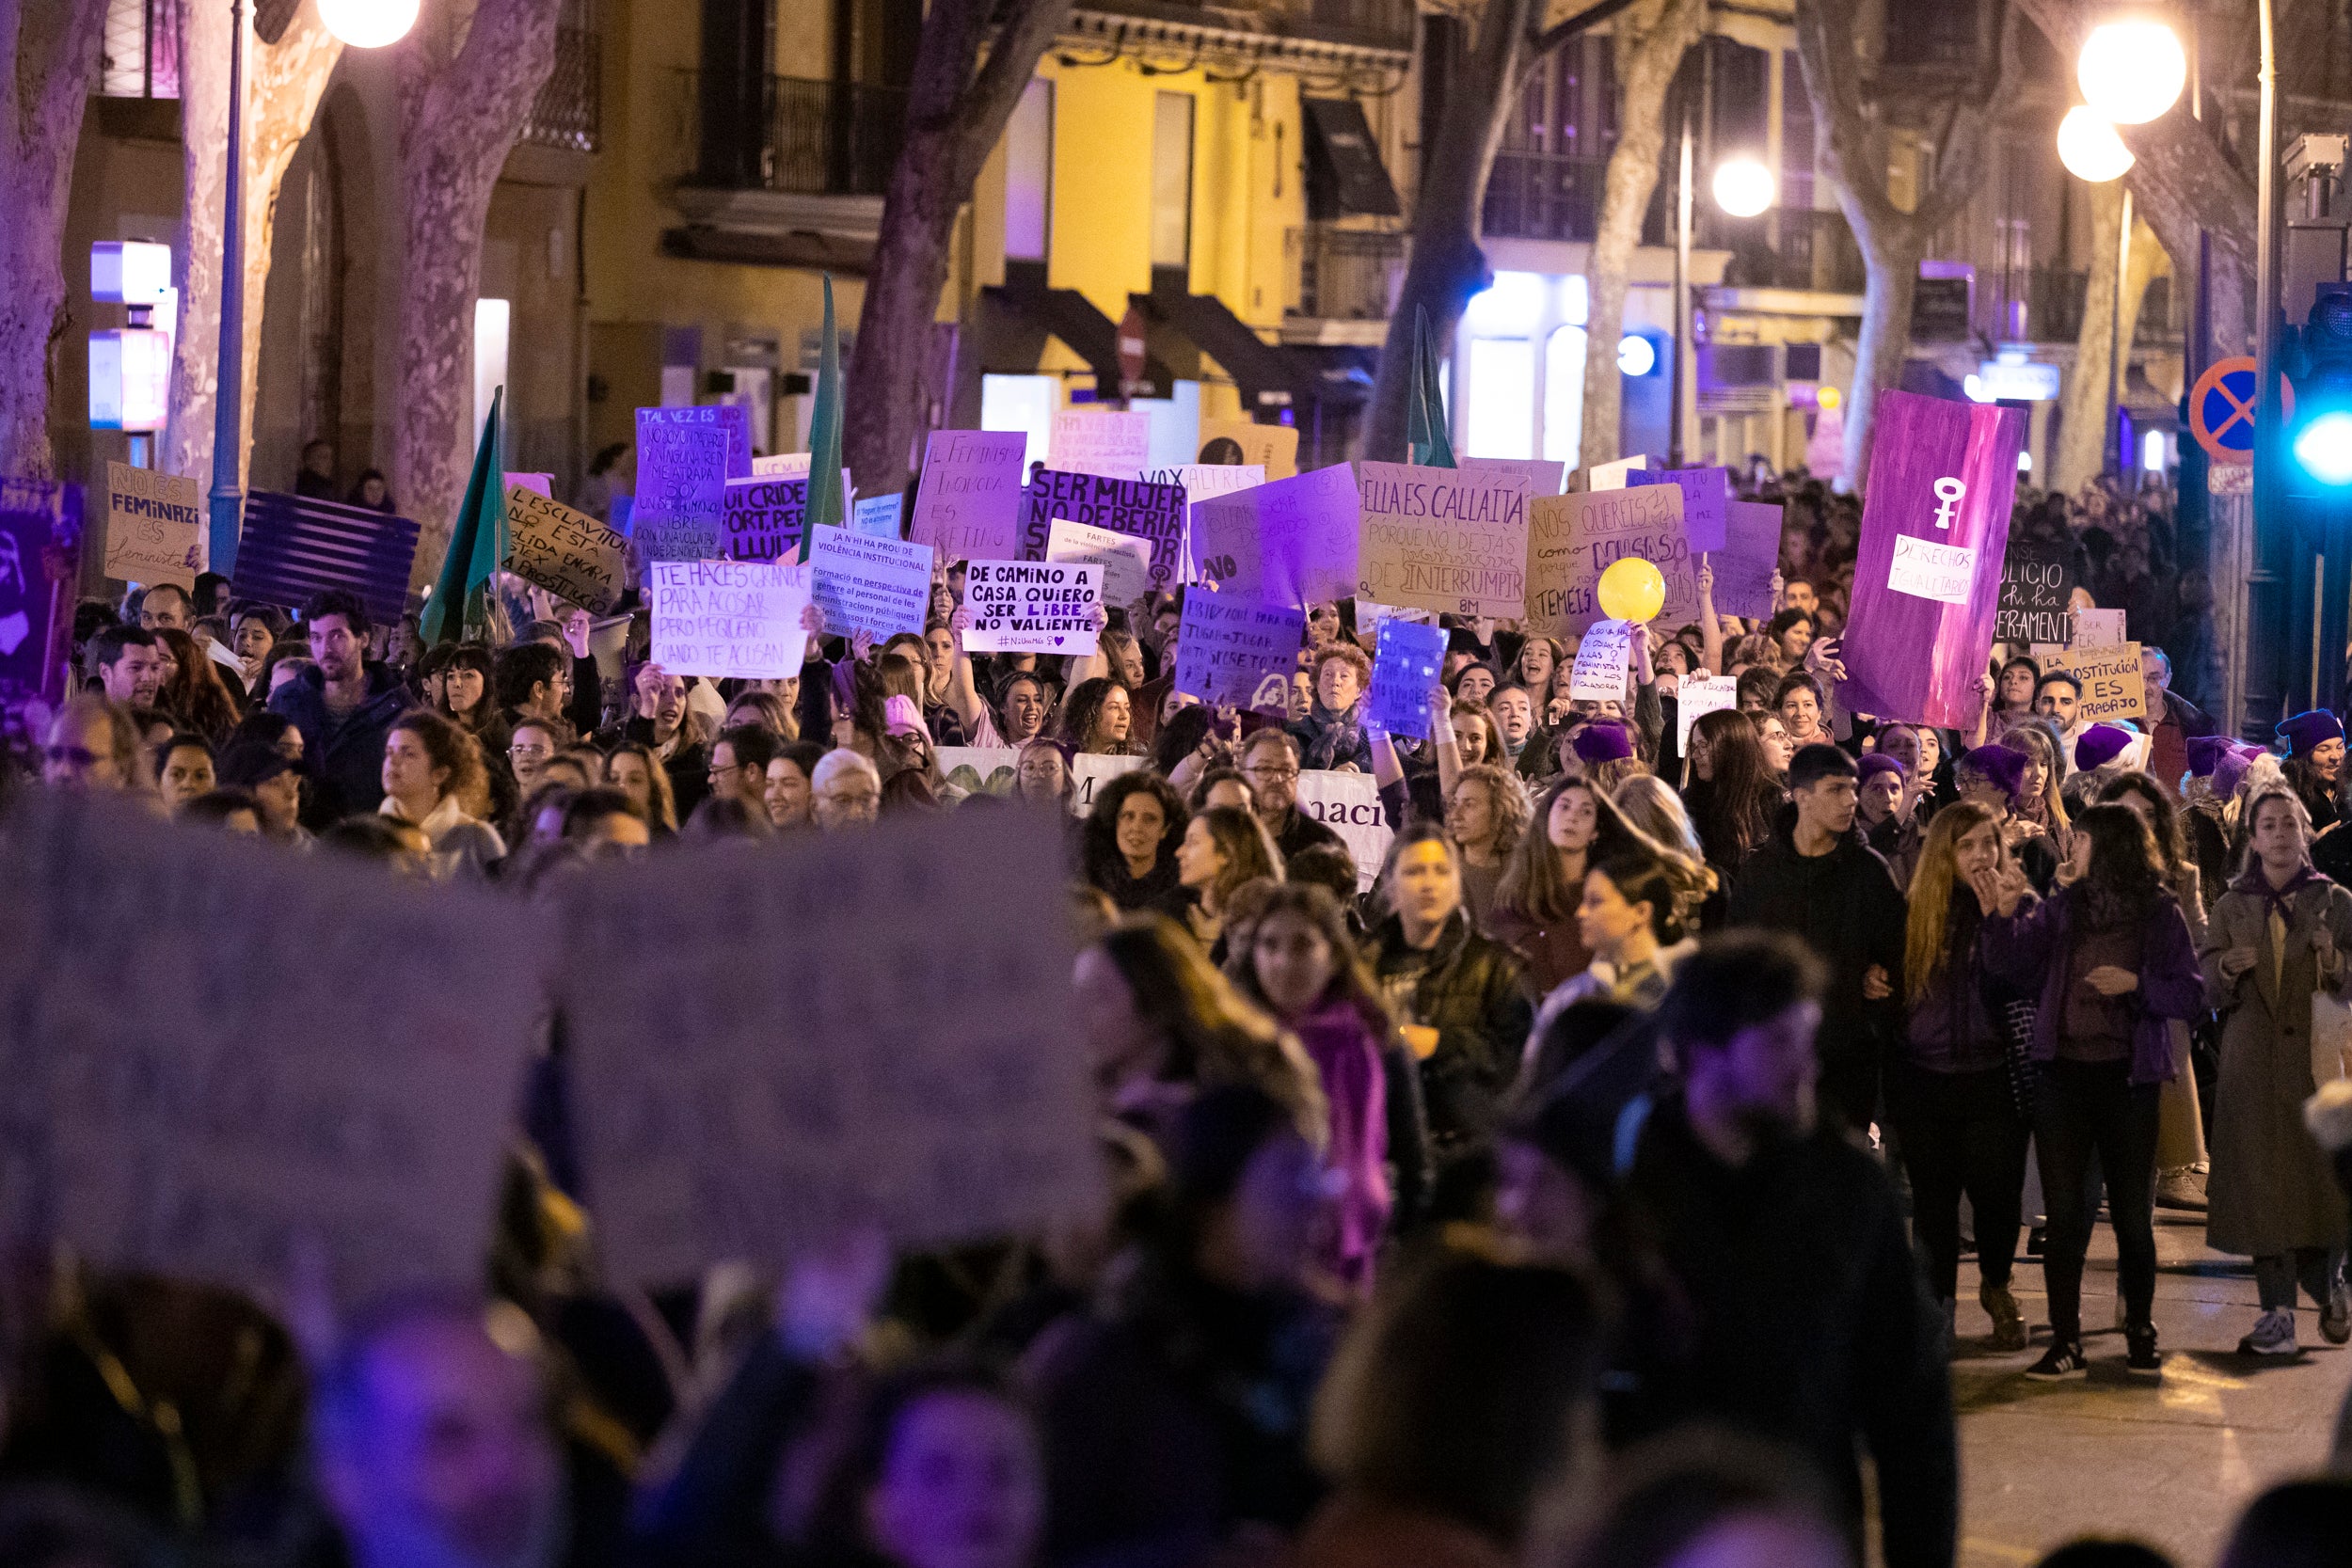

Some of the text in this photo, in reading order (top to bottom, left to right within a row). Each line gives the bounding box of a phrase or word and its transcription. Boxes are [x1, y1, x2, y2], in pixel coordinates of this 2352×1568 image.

[641, 409, 715, 422] TAL VEZ ES
[657, 449, 699, 465] NINGUNA
[704, 451, 723, 466] RED
[948, 436, 1024, 465] FEMINISMO
[652, 466, 669, 480] ME
[1691, 472, 1708, 484] TU
[112, 467, 183, 502] NO ES
[664, 481, 699, 499] SOY
[748, 478, 807, 510] CRIDE
[1033, 470, 1090, 503] SER
[1094, 477, 1186, 515] MUJER
[640, 497, 656, 510] UN
[931, 504, 956, 521] ES
[1031, 498, 1069, 523] NO
[1364, 480, 1523, 525] ELLA ES CALLAITA
[508, 506, 540, 529] NO
[659, 515, 699, 530] LIBRE
[722, 508, 771, 534] ORT,
[1532, 507, 1571, 542] NOS
[137, 518, 165, 544] ES
[636, 528, 657, 542] CON
[1087, 532, 1117, 546] FARTES
[1369, 523, 1422, 547] PORQUE
[1427, 530, 1449, 549] NO
[643, 544, 713, 560] INDEPENDIENTE
[833, 532, 843, 542] JA
[864, 537, 876, 548] HA
[877, 542, 900, 553] PROU
[901, 546, 914, 556] DE
[1537, 545, 1589, 559] como
[1896, 538, 1972, 570] DERECHOS
[818, 542, 926, 572] VIOLÈNCIA INSTITUCIONAL
[1083, 555, 1113, 568] FARTES
[1203, 554, 1237, 581] NO
[655, 562, 806, 589] TE HACES GRANDE
[813, 566, 924, 597] Formació en perspectiva de
[971, 566, 990, 581] DE
[1075, 571, 1089, 584] A
[1369, 562, 1393, 588] DE
[1406, 563, 1522, 597] INTERRUMPIR
[660, 588, 770, 619] PARA ACOSAR
[846, 586, 854, 595] al
[855, 590, 891, 604] personal
[892, 596, 902, 606] de
[904, 598, 915, 609] les
[972, 585, 1022, 602] CASA,
[1536, 586, 1592, 618] TEMÉIS
[2003, 584, 2060, 607] hi ha
[875, 607, 915, 623] públiques
[984, 604, 1016, 618] SER
[1459, 599, 1479, 612] 8M
[660, 617, 694, 640] PERO
[822, 607, 836, 617] els
[837, 611, 865, 624] cossos
[870, 617, 894, 629] forces
[896, 624, 907, 633] de
[976, 619, 1001, 631] NO
[653, 642, 784, 667] CUANDO TE ACUSAN
[1588, 651, 1603, 659] LAS
[2046, 657, 2064, 669] LA
[1577, 660, 1621, 672] FEMINISTAS
[1573, 680, 1619, 690] VIOLADORES
[2094, 679, 2123, 698] ES
[2079, 697, 2138, 719] TRABAJO
